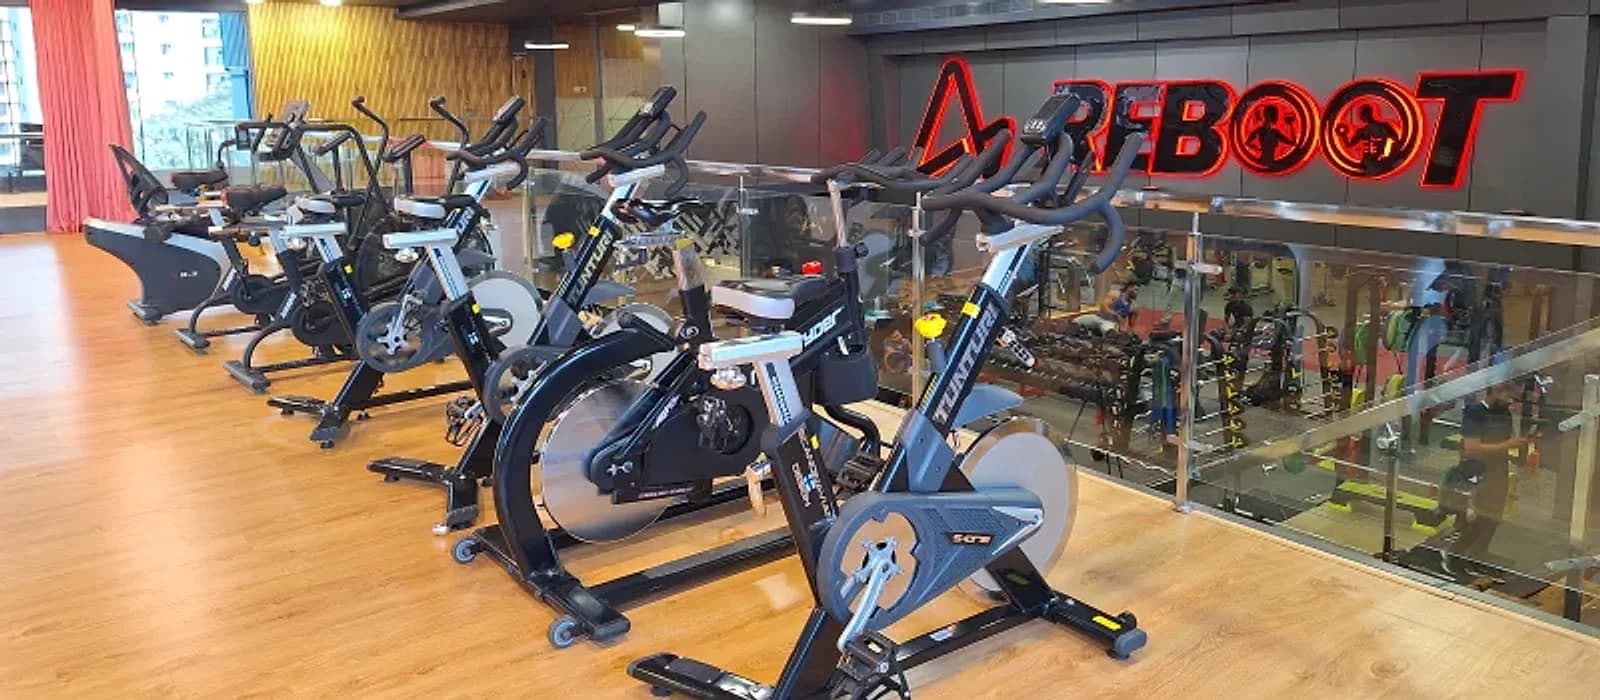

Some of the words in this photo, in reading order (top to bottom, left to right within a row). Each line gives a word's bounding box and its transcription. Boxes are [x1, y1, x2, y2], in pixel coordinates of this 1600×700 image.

[1050, 68, 1523, 190] REBOOT
[565, 229, 614, 305] TUNTURI
[932, 303, 1000, 425] TUNTURI
